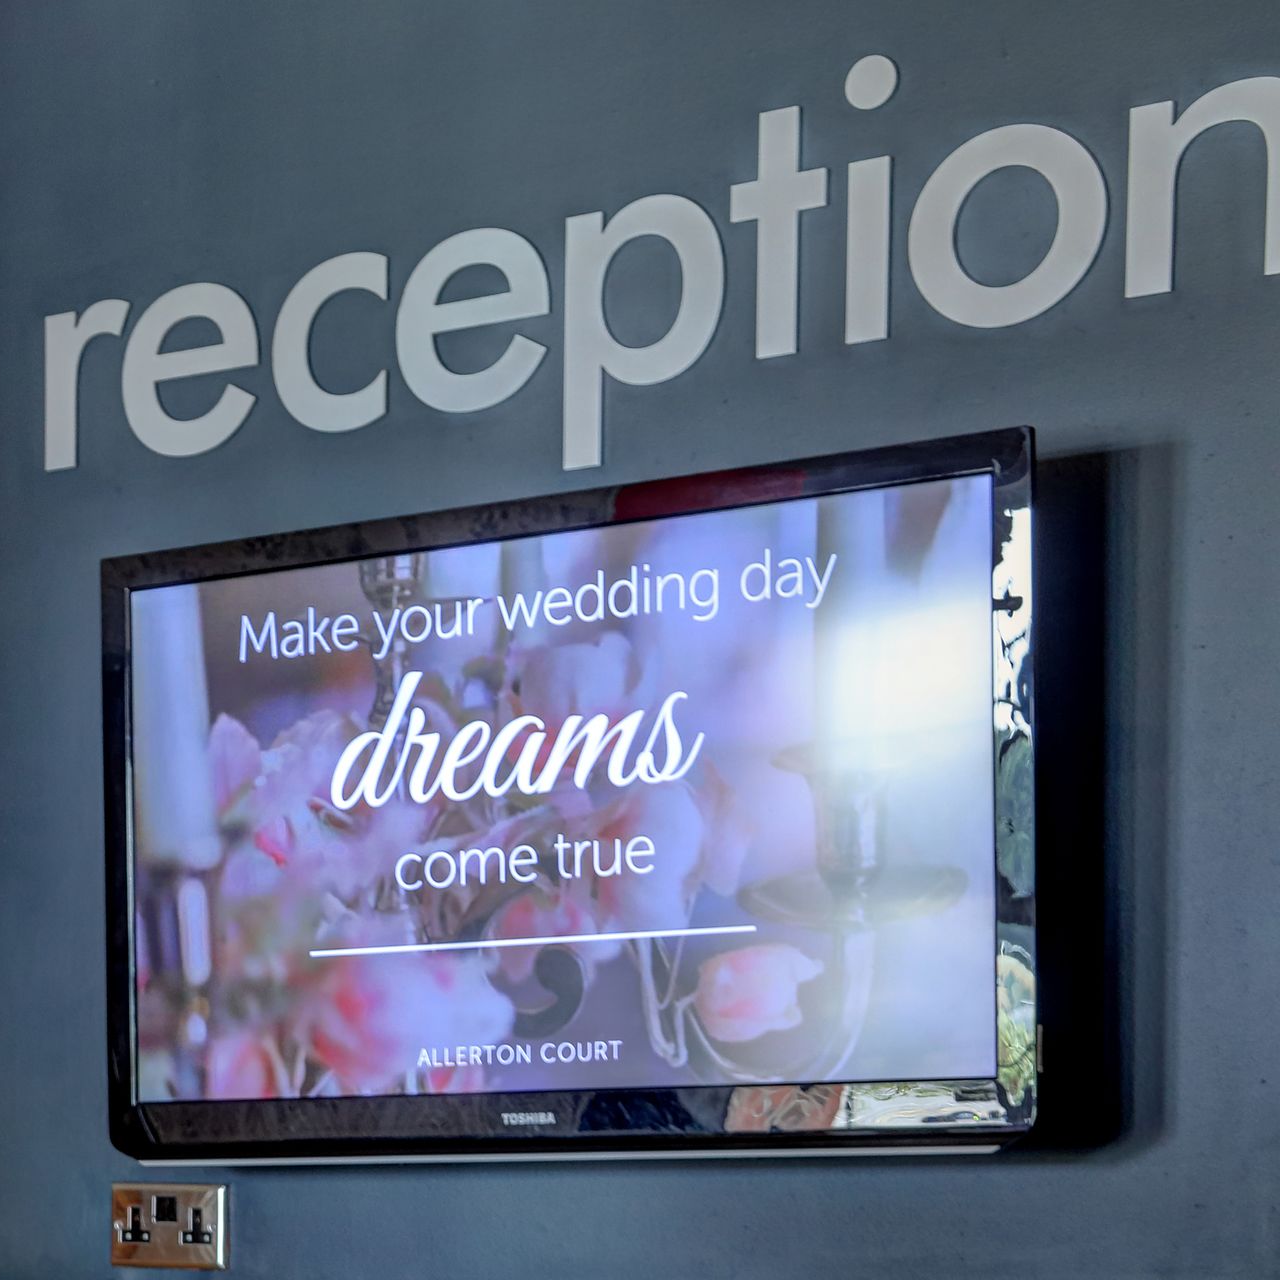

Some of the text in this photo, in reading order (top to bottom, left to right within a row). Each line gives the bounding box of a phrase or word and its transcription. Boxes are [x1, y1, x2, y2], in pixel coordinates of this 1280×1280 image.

[44, 54, 1280, 471] reception
[239, 548, 837, 663] Make your wedding day
[330, 671, 705, 810] dreams
[394, 833, 656, 890] come true
[417, 1040, 623, 1068] ALLERTON COURT
[501, 1112, 556, 1126] TOSHIBA
